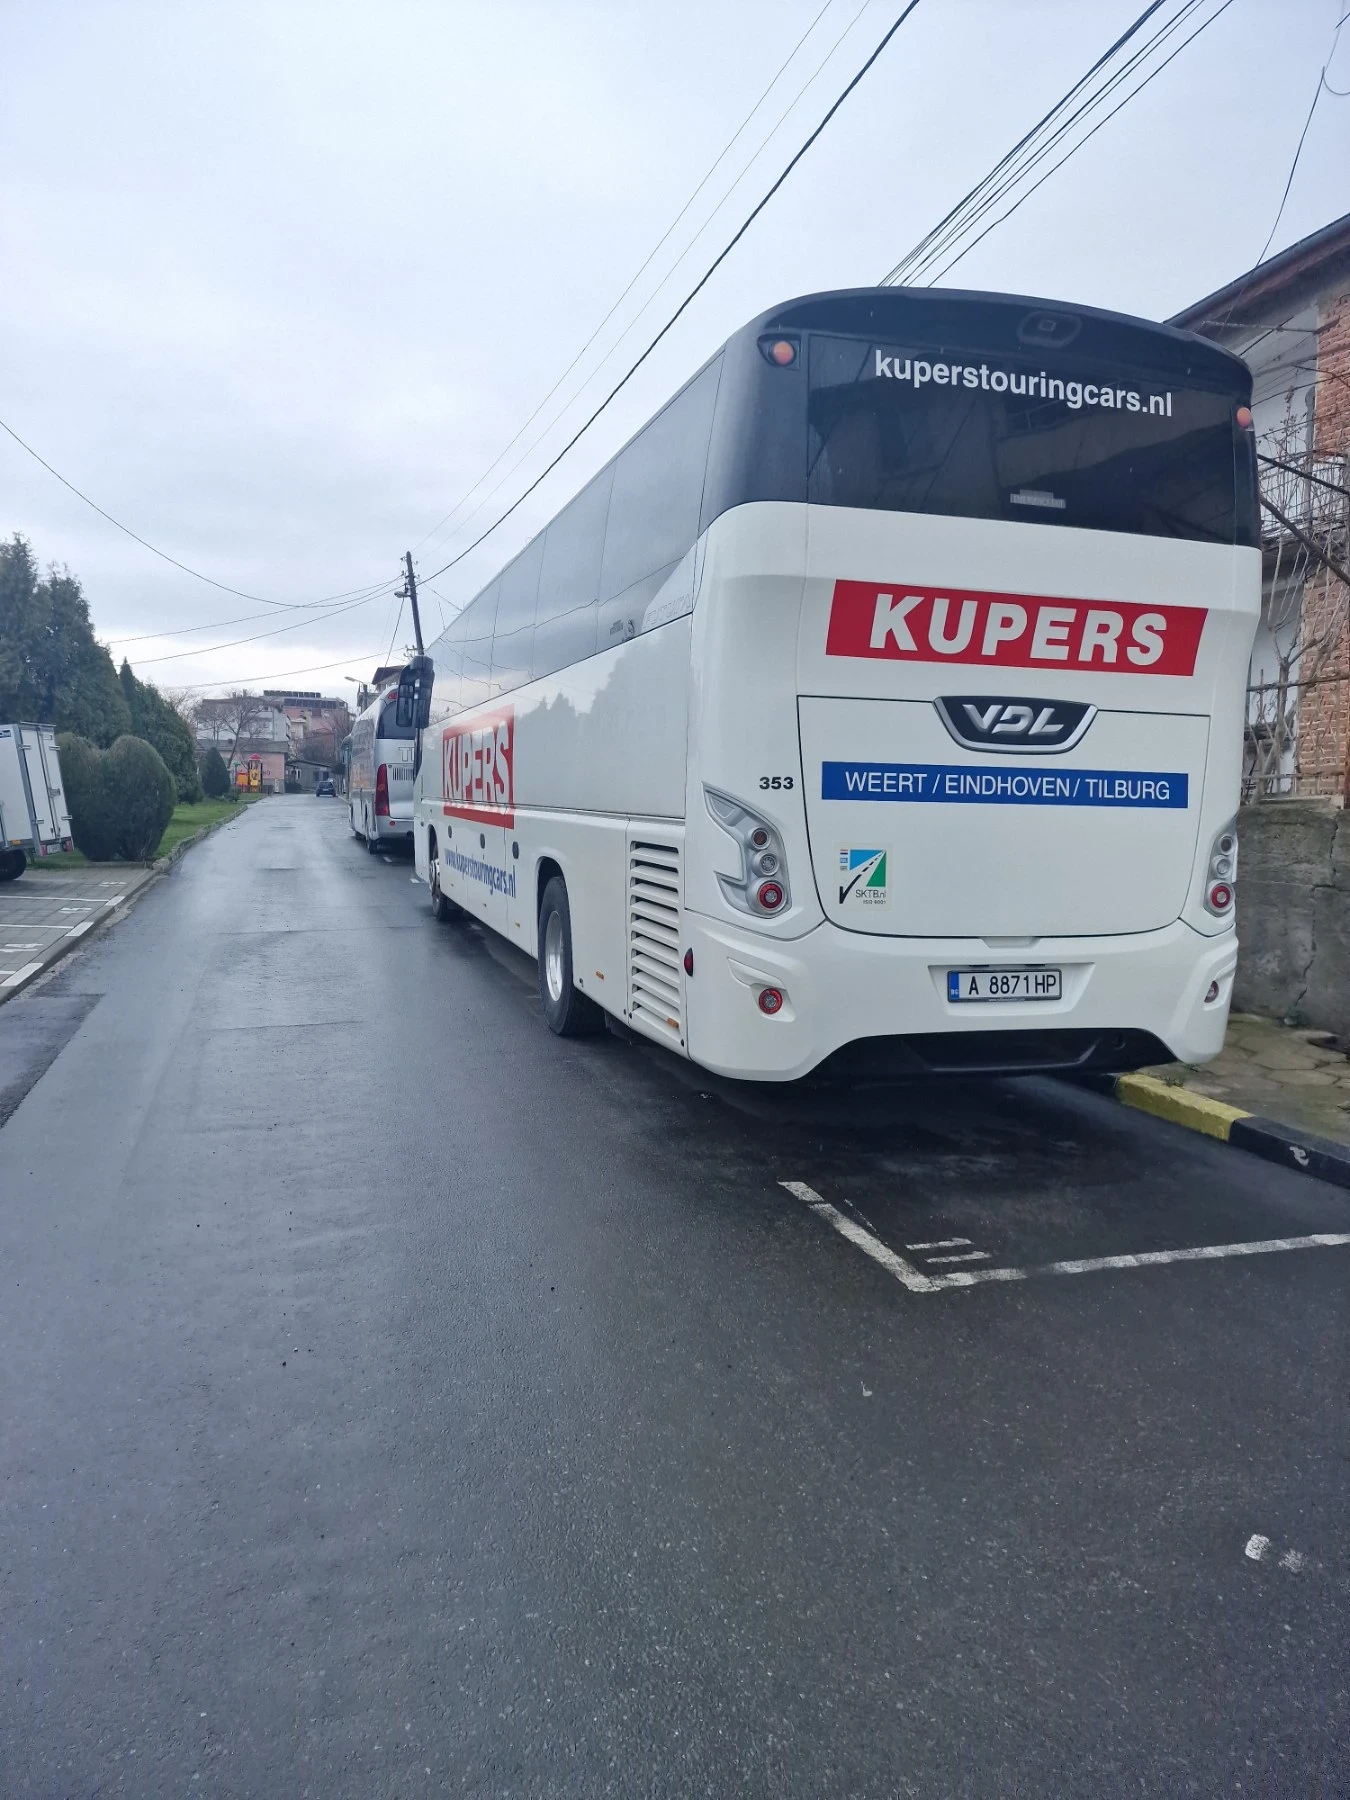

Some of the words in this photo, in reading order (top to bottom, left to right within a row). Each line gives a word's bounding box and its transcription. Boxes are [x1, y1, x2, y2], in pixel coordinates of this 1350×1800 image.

[875, 349, 1172, 416] kuperstouringcars.nl
[869, 593, 1167, 665] KUPERS
[962, 704, 1065, 736] VDL
[443, 720, 509, 813] KUPERS
[759, 776, 794, 790] 353
[845, 771, 928, 793] WEERT
[1085, 779, 1170, 800] TILBURG
[444, 845, 516, 899] www.kuperstouringcars.nl
[968, 975, 980, 996] A
